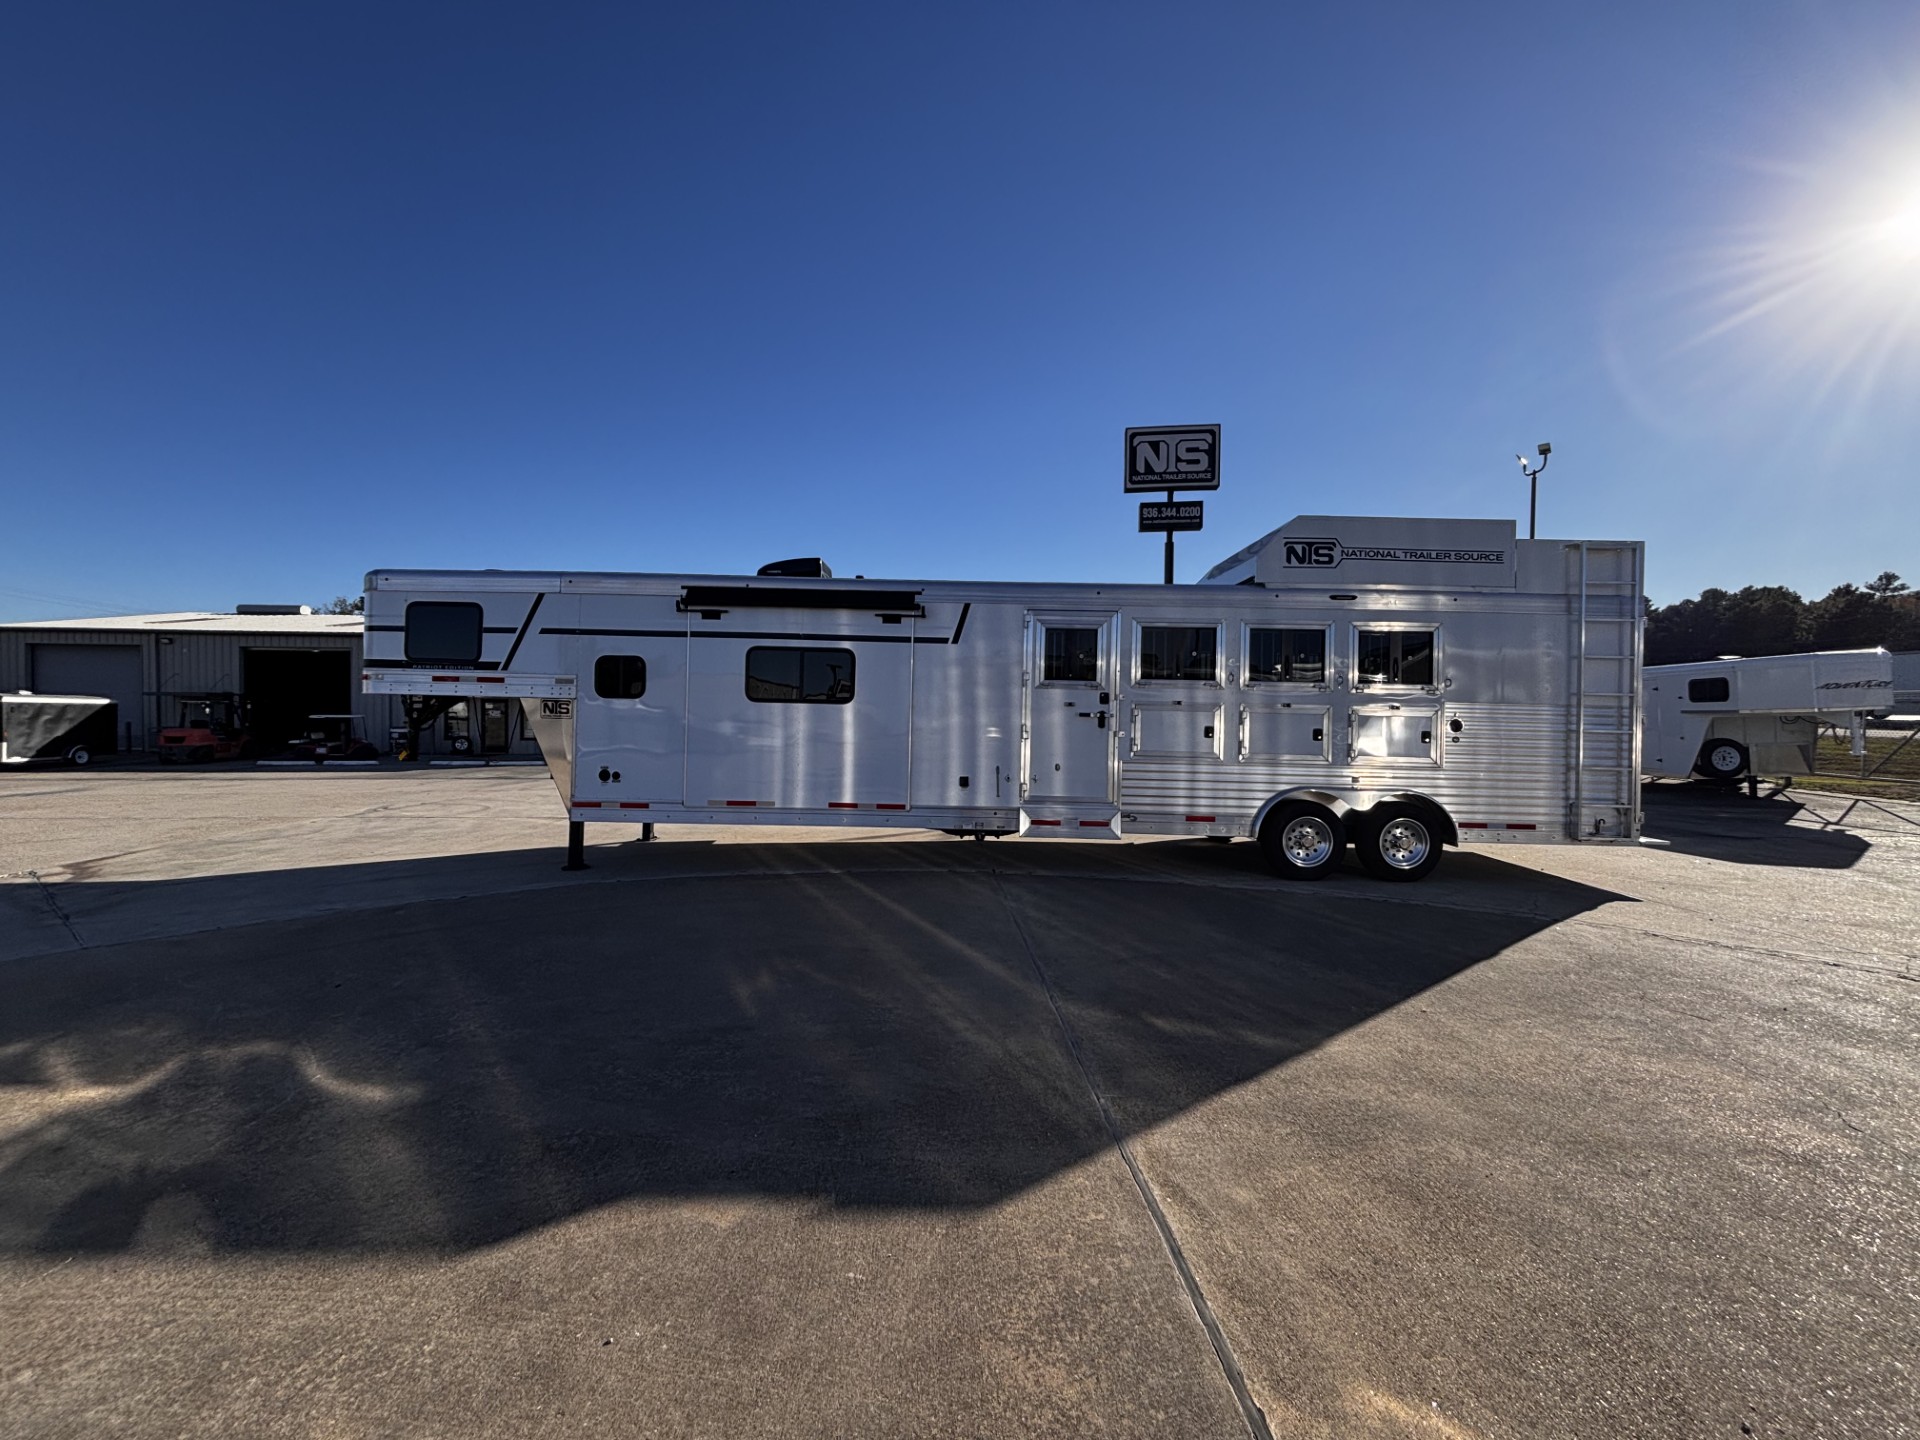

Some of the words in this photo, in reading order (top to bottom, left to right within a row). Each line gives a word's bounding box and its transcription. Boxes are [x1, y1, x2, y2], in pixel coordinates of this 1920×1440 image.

[1133, 433, 1212, 473] NTS
[1142, 506, 1201, 518] 936.344.0200
[1284, 541, 1337, 566] NTS
[1340, 548, 1401, 559] NATIONAL
[1402, 551, 1452, 561] TRAILER
[1454, 552, 1504, 562] SOURCE
[541, 700, 572, 715] NTS
